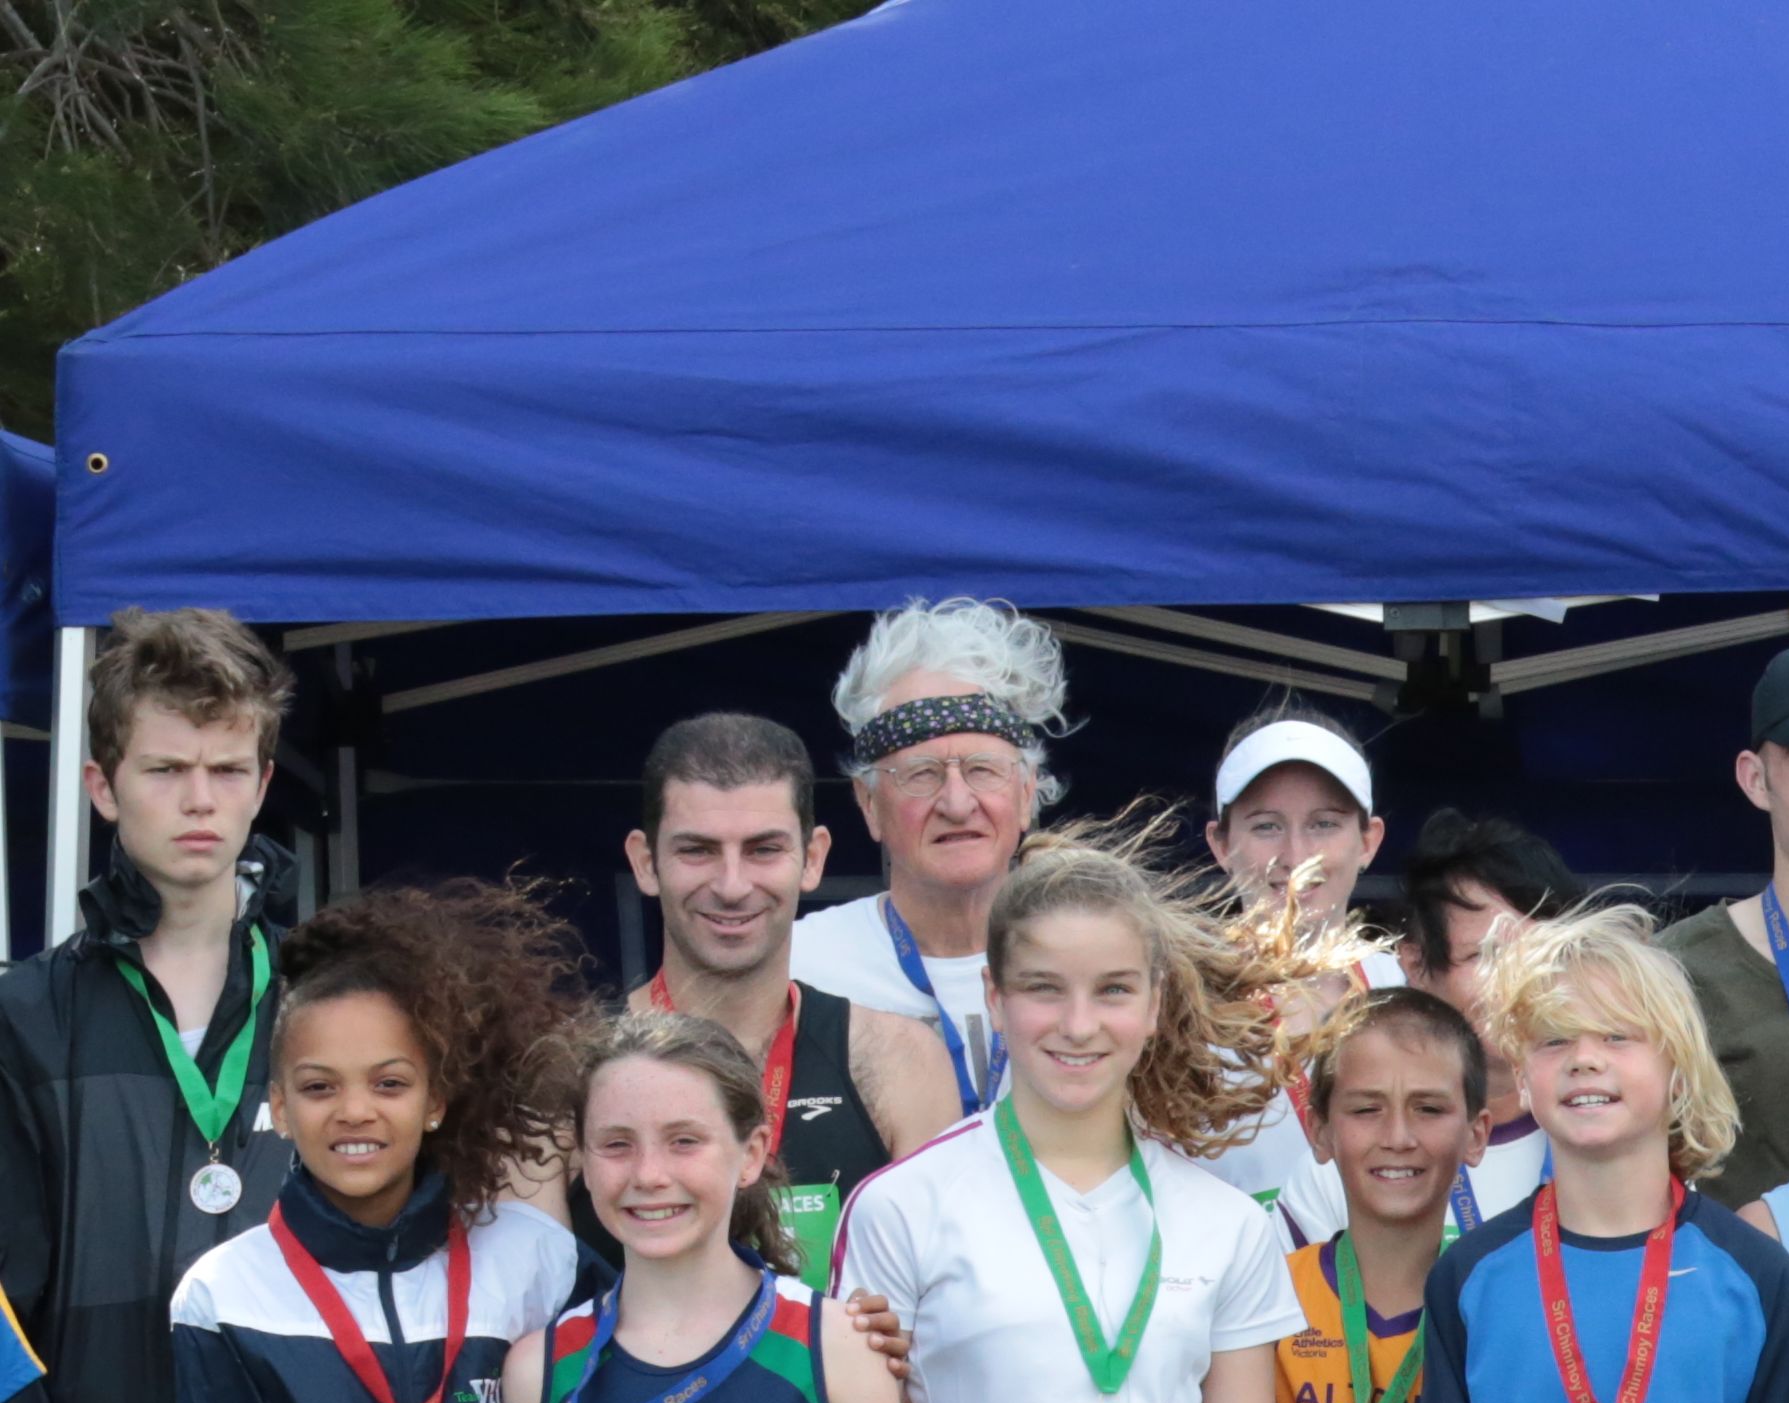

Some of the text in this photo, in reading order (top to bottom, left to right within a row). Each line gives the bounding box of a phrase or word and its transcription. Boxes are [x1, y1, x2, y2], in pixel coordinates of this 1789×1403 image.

[787, 1096, 843, 1109] BROOKS
[778, 1194, 826, 1213] ACES
[1551, 1299, 1566, 1321] Sri
[1637, 1286, 1659, 1335] Races
[1291, 1337, 1344, 1349] Athletics
[1291, 1348, 1328, 1359] Victoria
[1555, 1321, 1583, 1393] Chinmoy
